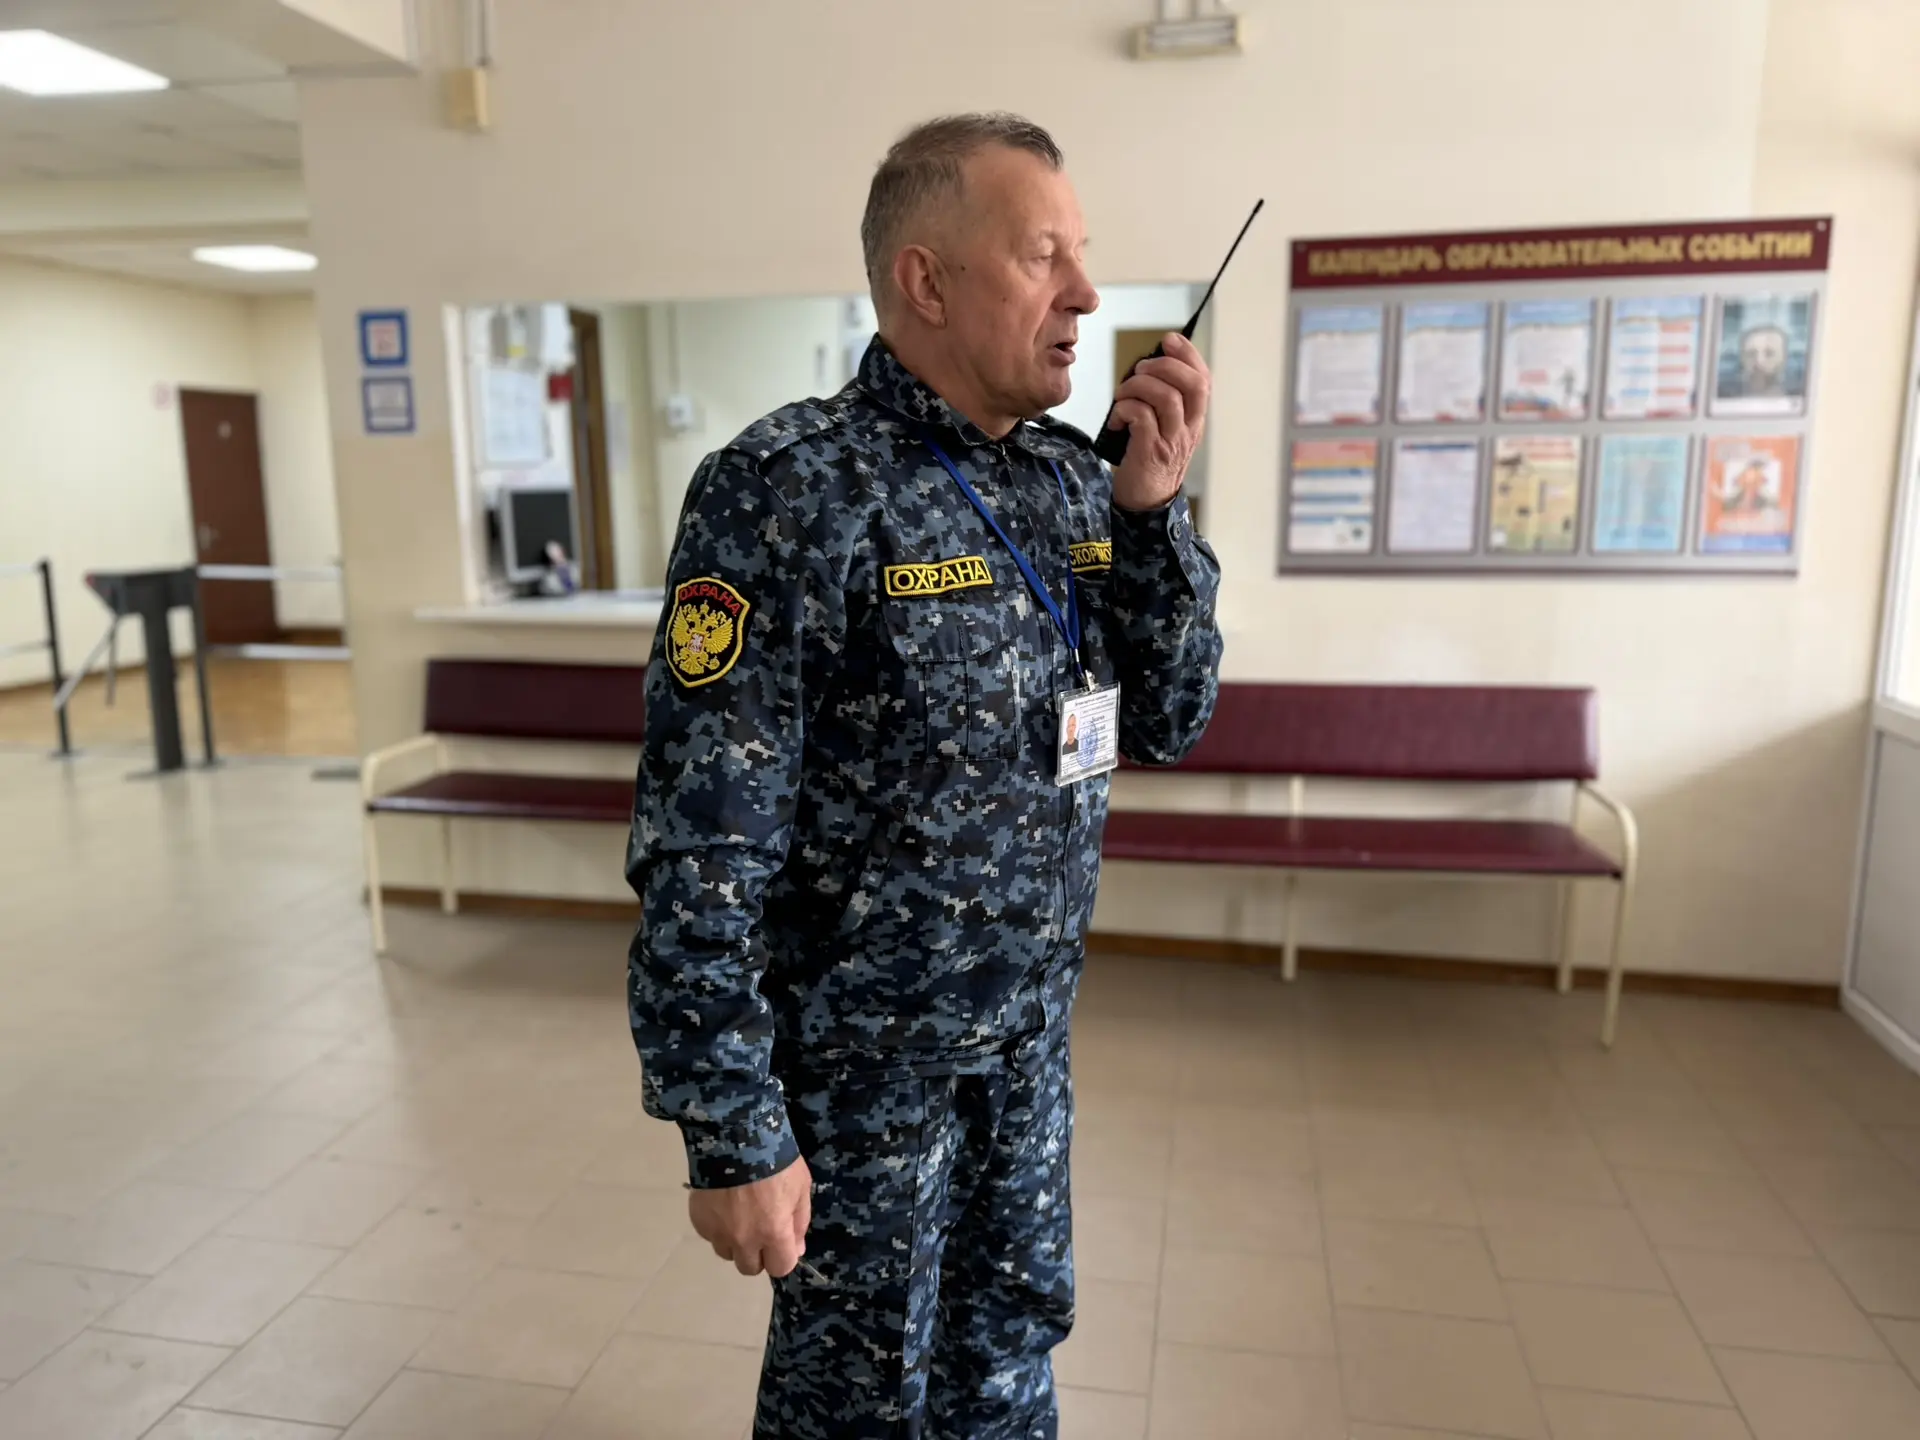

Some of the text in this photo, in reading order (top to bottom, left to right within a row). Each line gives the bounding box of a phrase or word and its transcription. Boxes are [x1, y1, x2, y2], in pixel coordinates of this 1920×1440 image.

[1308, 246, 1442, 276] КАЛЕНДАРЬ
[1446, 235, 1684, 270] ОБРАЗОВАТЕЛЬНЫХ
[893, 561, 987, 590] ОХРАНА
[680, 584, 740, 616] ОХРАНА
